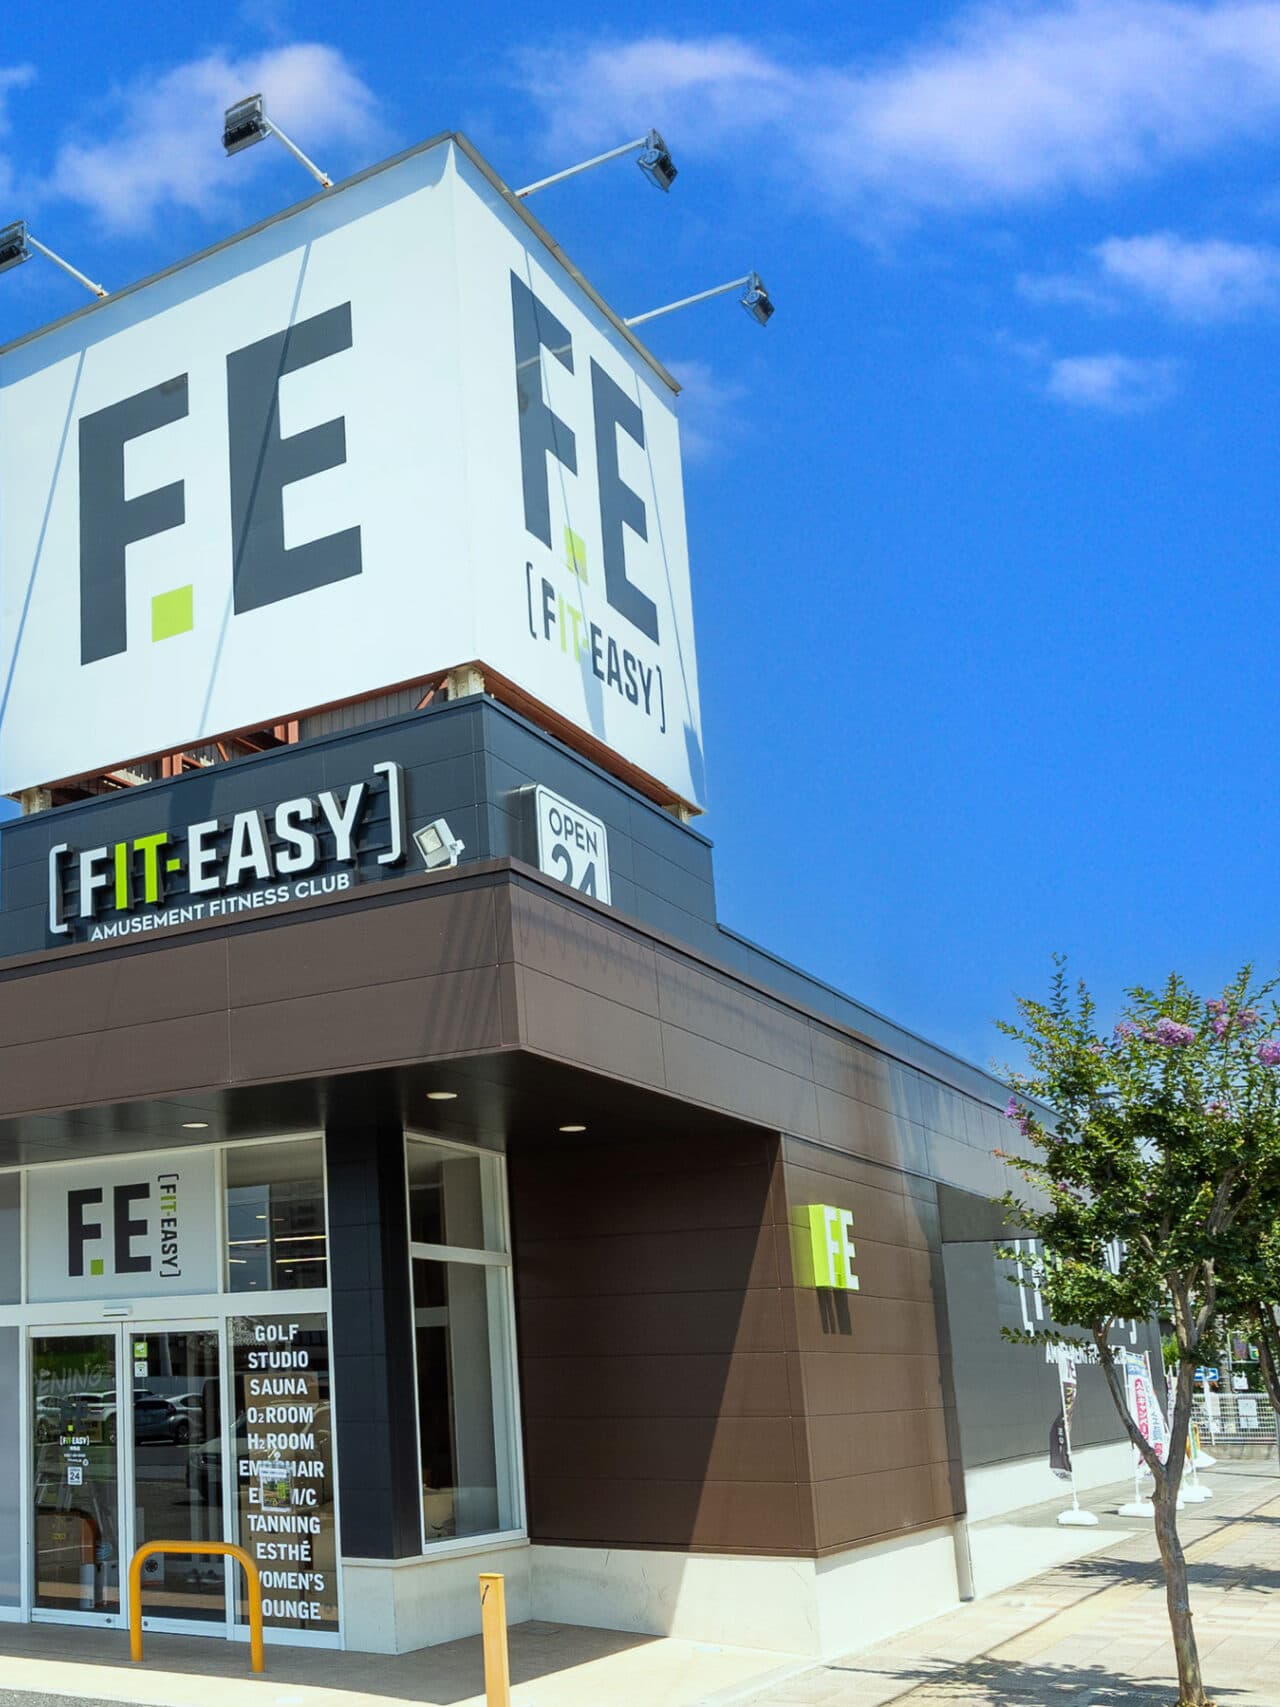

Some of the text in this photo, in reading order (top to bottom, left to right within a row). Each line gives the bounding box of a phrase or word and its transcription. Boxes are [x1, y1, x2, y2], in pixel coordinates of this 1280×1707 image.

[549, 808, 598, 857] OPEN
[91, 873, 350, 941] AMUSEMENT FITNESS CLUB
[254, 1324, 299, 1342] GOLF
[248, 1351, 308, 1369] STUDIO
[250, 1378, 308, 1396] SAUNA
[70, 1472, 80, 1481] 24
[247, 1514, 320, 1534] TANNING
[256, 1540, 311, 1562] ESTHÉ
[259, 1572, 325, 1591] OMEN'S
[262, 1600, 321, 1620] OUNGE
